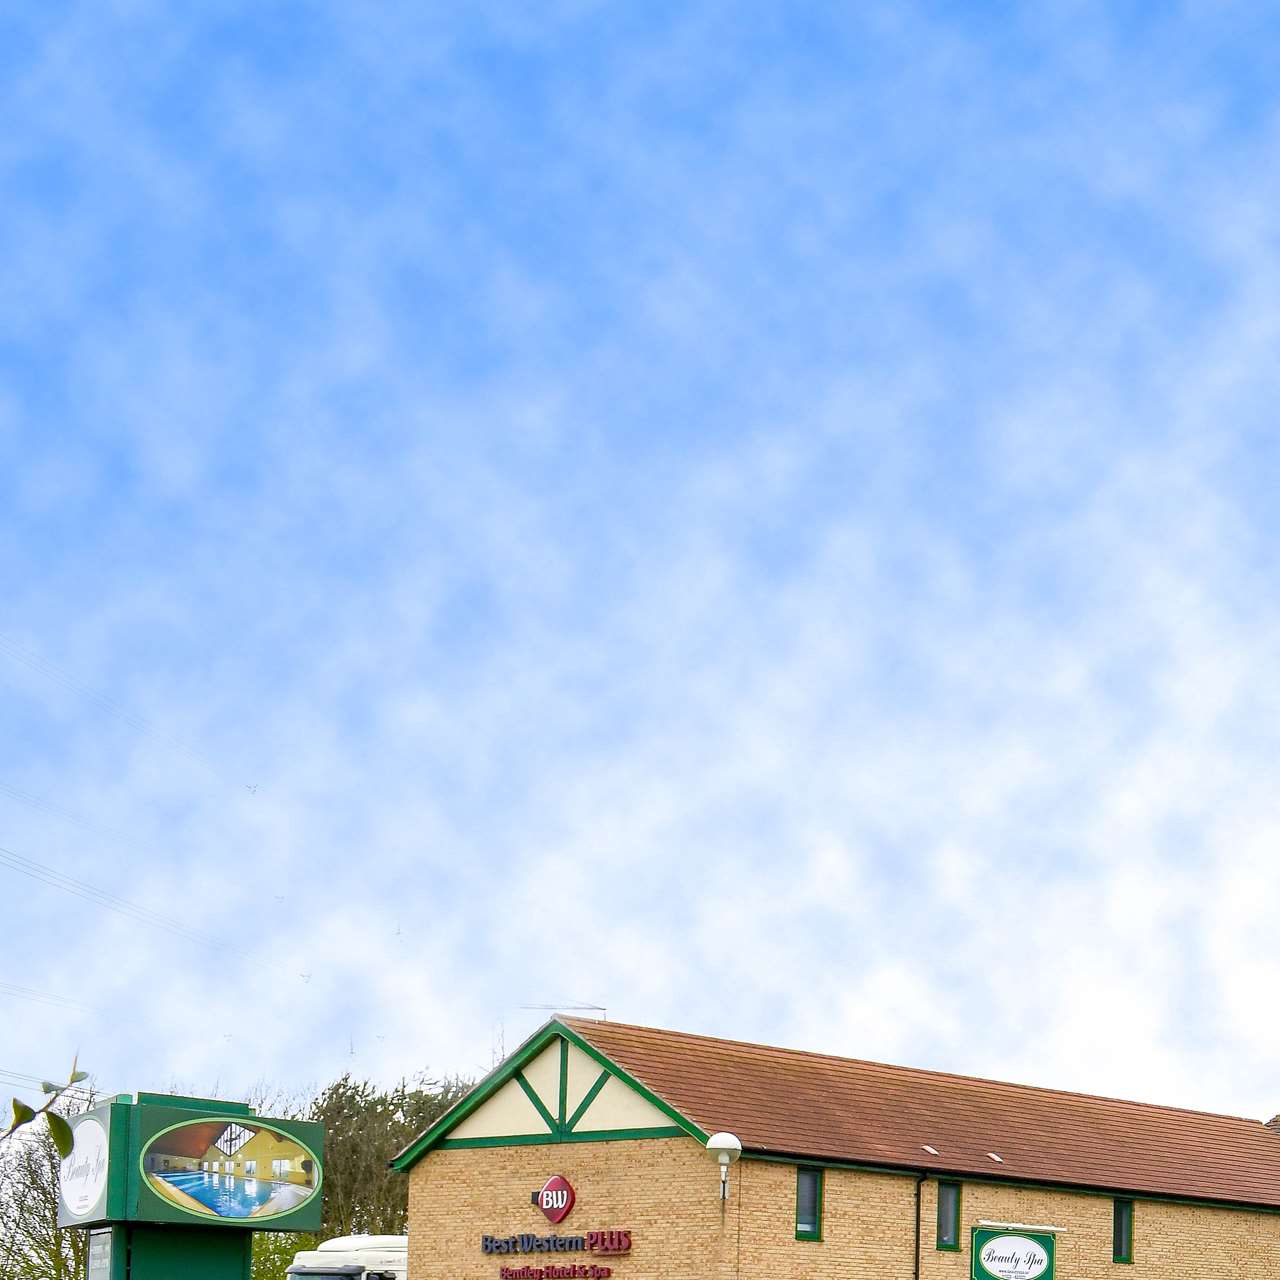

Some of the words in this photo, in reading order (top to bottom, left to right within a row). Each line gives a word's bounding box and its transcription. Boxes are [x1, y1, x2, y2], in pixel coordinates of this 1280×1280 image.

[542, 1190, 567, 1209] BW
[482, 1235, 516, 1252] Best
[518, 1233, 584, 1252] Western
[587, 1231, 631, 1250] PLUS
[983, 1247, 1021, 1270] Beauty
[1024, 1250, 1044, 1270] Spa
[500, 1266, 543, 1280] Bentley
[544, 1265, 576, 1279] Hotel
[577, 1265, 588, 1278] &
[588, 1265, 611, 1279] Spa
